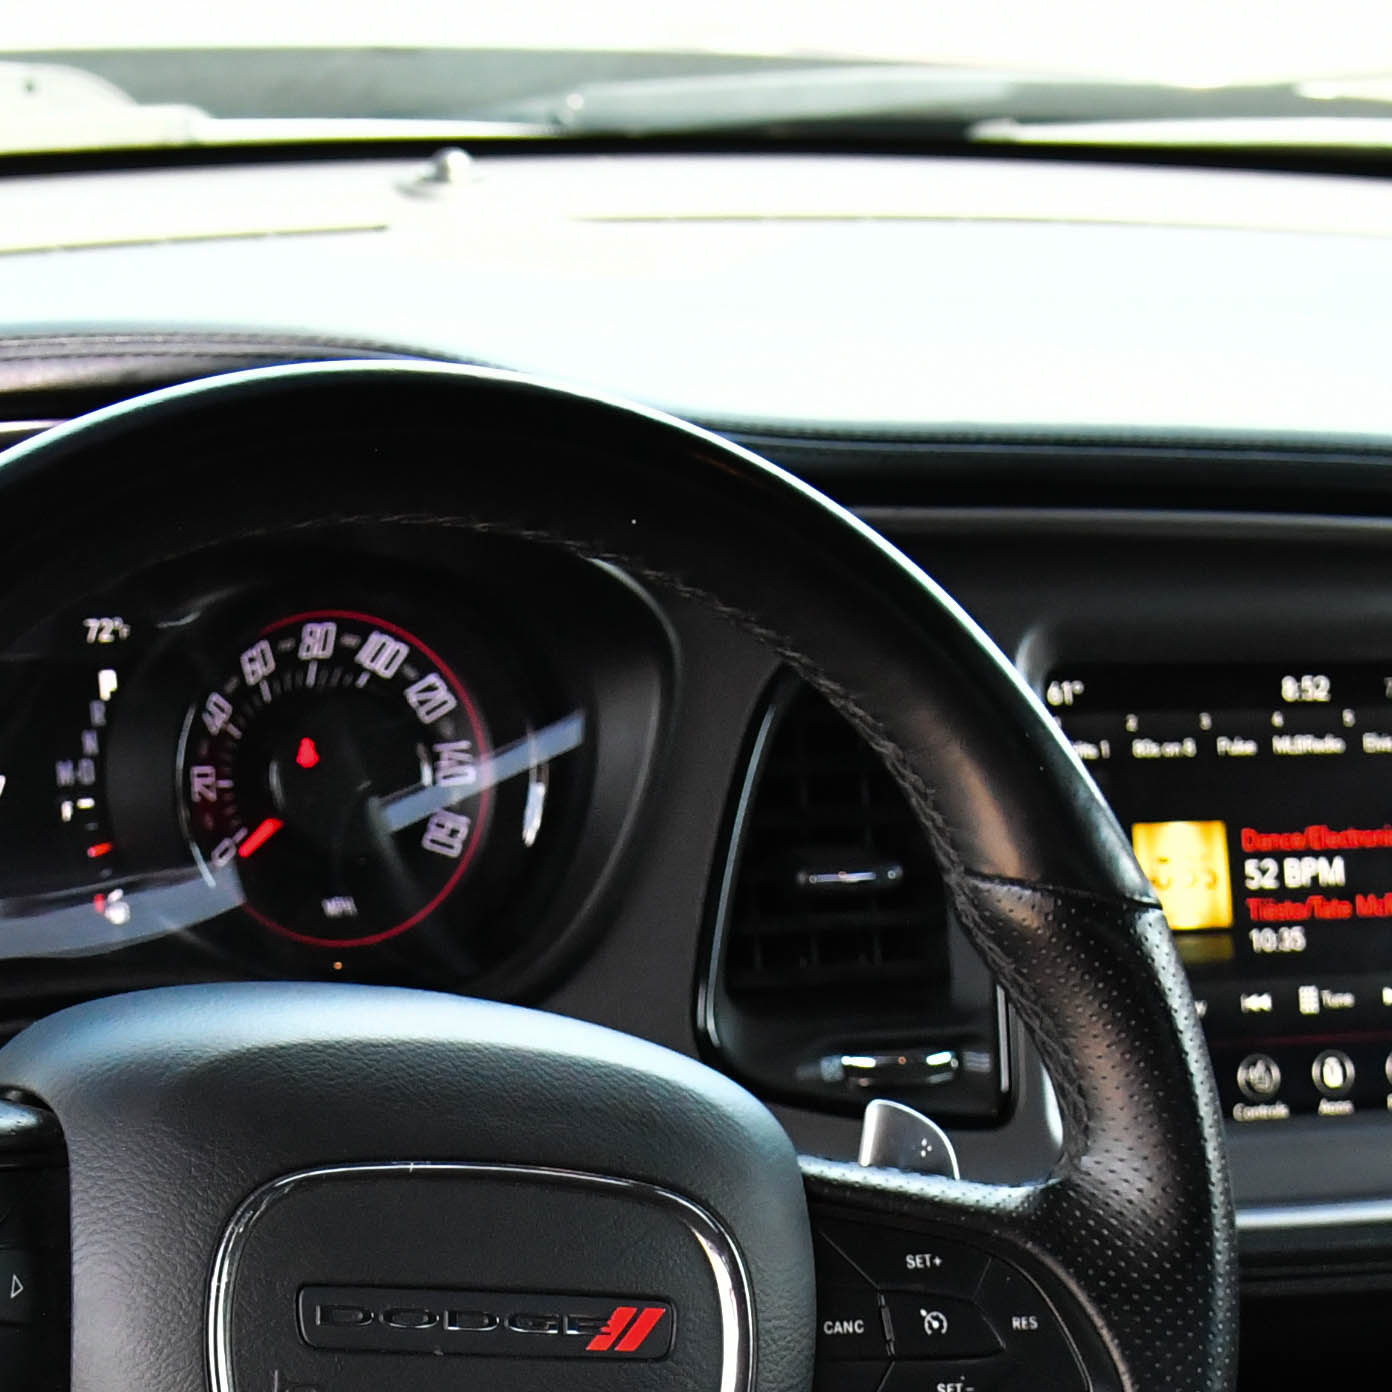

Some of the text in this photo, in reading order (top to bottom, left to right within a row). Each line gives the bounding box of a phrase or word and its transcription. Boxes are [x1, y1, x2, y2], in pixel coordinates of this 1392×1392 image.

[298, 622, 337, 660] 80
[354, 630, 410, 679] 100
[240, 640, 277, 686] 60
[97, 669, 118, 701] P
[404, 672, 458, 724] 120
[202, 692, 233, 735] 40
[433, 740, 477, 787] 140
[190, 765, 217, 802] 20
[210, 836, 237, 867] 0
[421, 808, 471, 858] 160
[1244, 857, 1281, 890] 52
[1283, 855, 1346, 888] BPM
[906, 1254, 943, 1269] SET+
[315, 1304, 611, 1336] DODGE
[823, 1320, 865, 1335] CANC
[1012, 1316, 1039, 1330] RES
